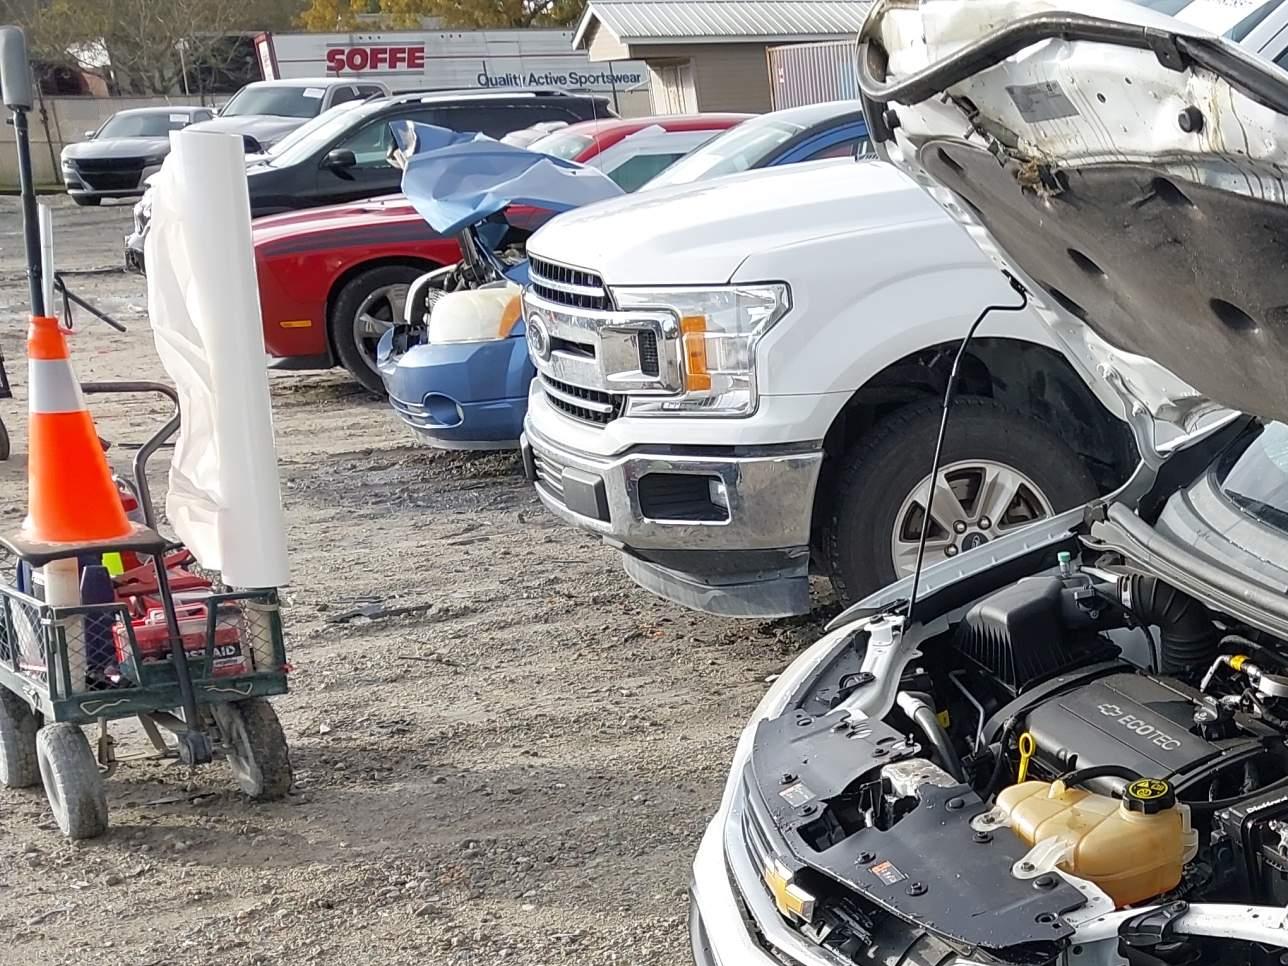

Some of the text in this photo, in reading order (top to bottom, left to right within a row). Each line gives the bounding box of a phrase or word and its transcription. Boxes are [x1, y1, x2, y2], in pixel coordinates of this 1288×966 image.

[326, 47, 425, 72] SOFFE
[528, 72, 567, 86] Active
[568, 71, 642, 87] Sportswear
[213, 645, 236, 658] AID
[1117, 714, 1181, 751] ECOTEC
